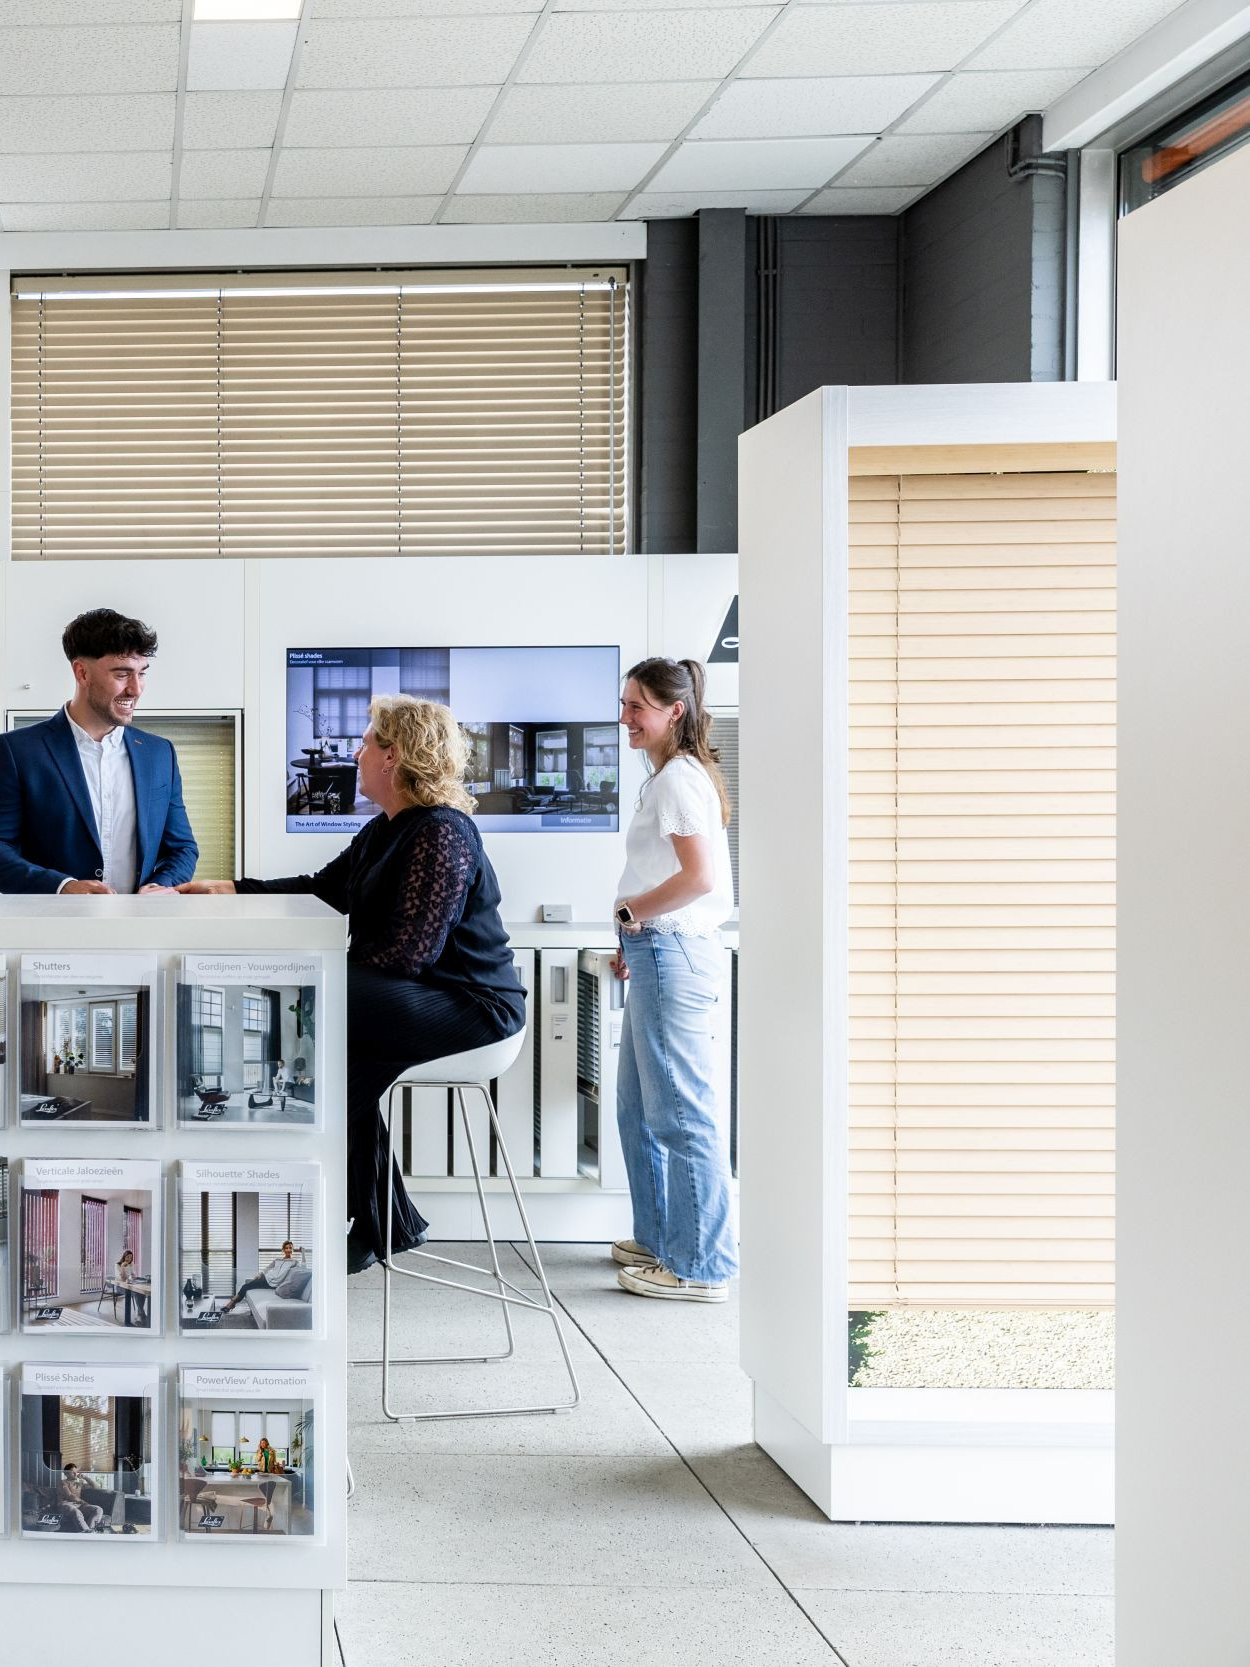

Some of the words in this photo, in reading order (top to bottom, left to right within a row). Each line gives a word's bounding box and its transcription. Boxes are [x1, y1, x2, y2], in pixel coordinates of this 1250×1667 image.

[560, 816, 592, 824] Informatie
[32, 961, 71, 971] Shutters
[197, 961, 241, 973] Gordijnen
[247, 962, 316, 973] Vouwgordijnen
[36, 1166, 75, 1176] Verticale
[75, 1166, 124, 1176] Jaloezieën
[246, 1169, 280, 1179] Shades
[35, 1372, 61, 1382] Plissé
[61, 1373, 95, 1383] Shades
[196, 1375, 247, 1385] PowerView
[252, 1376, 307, 1385] Automation
